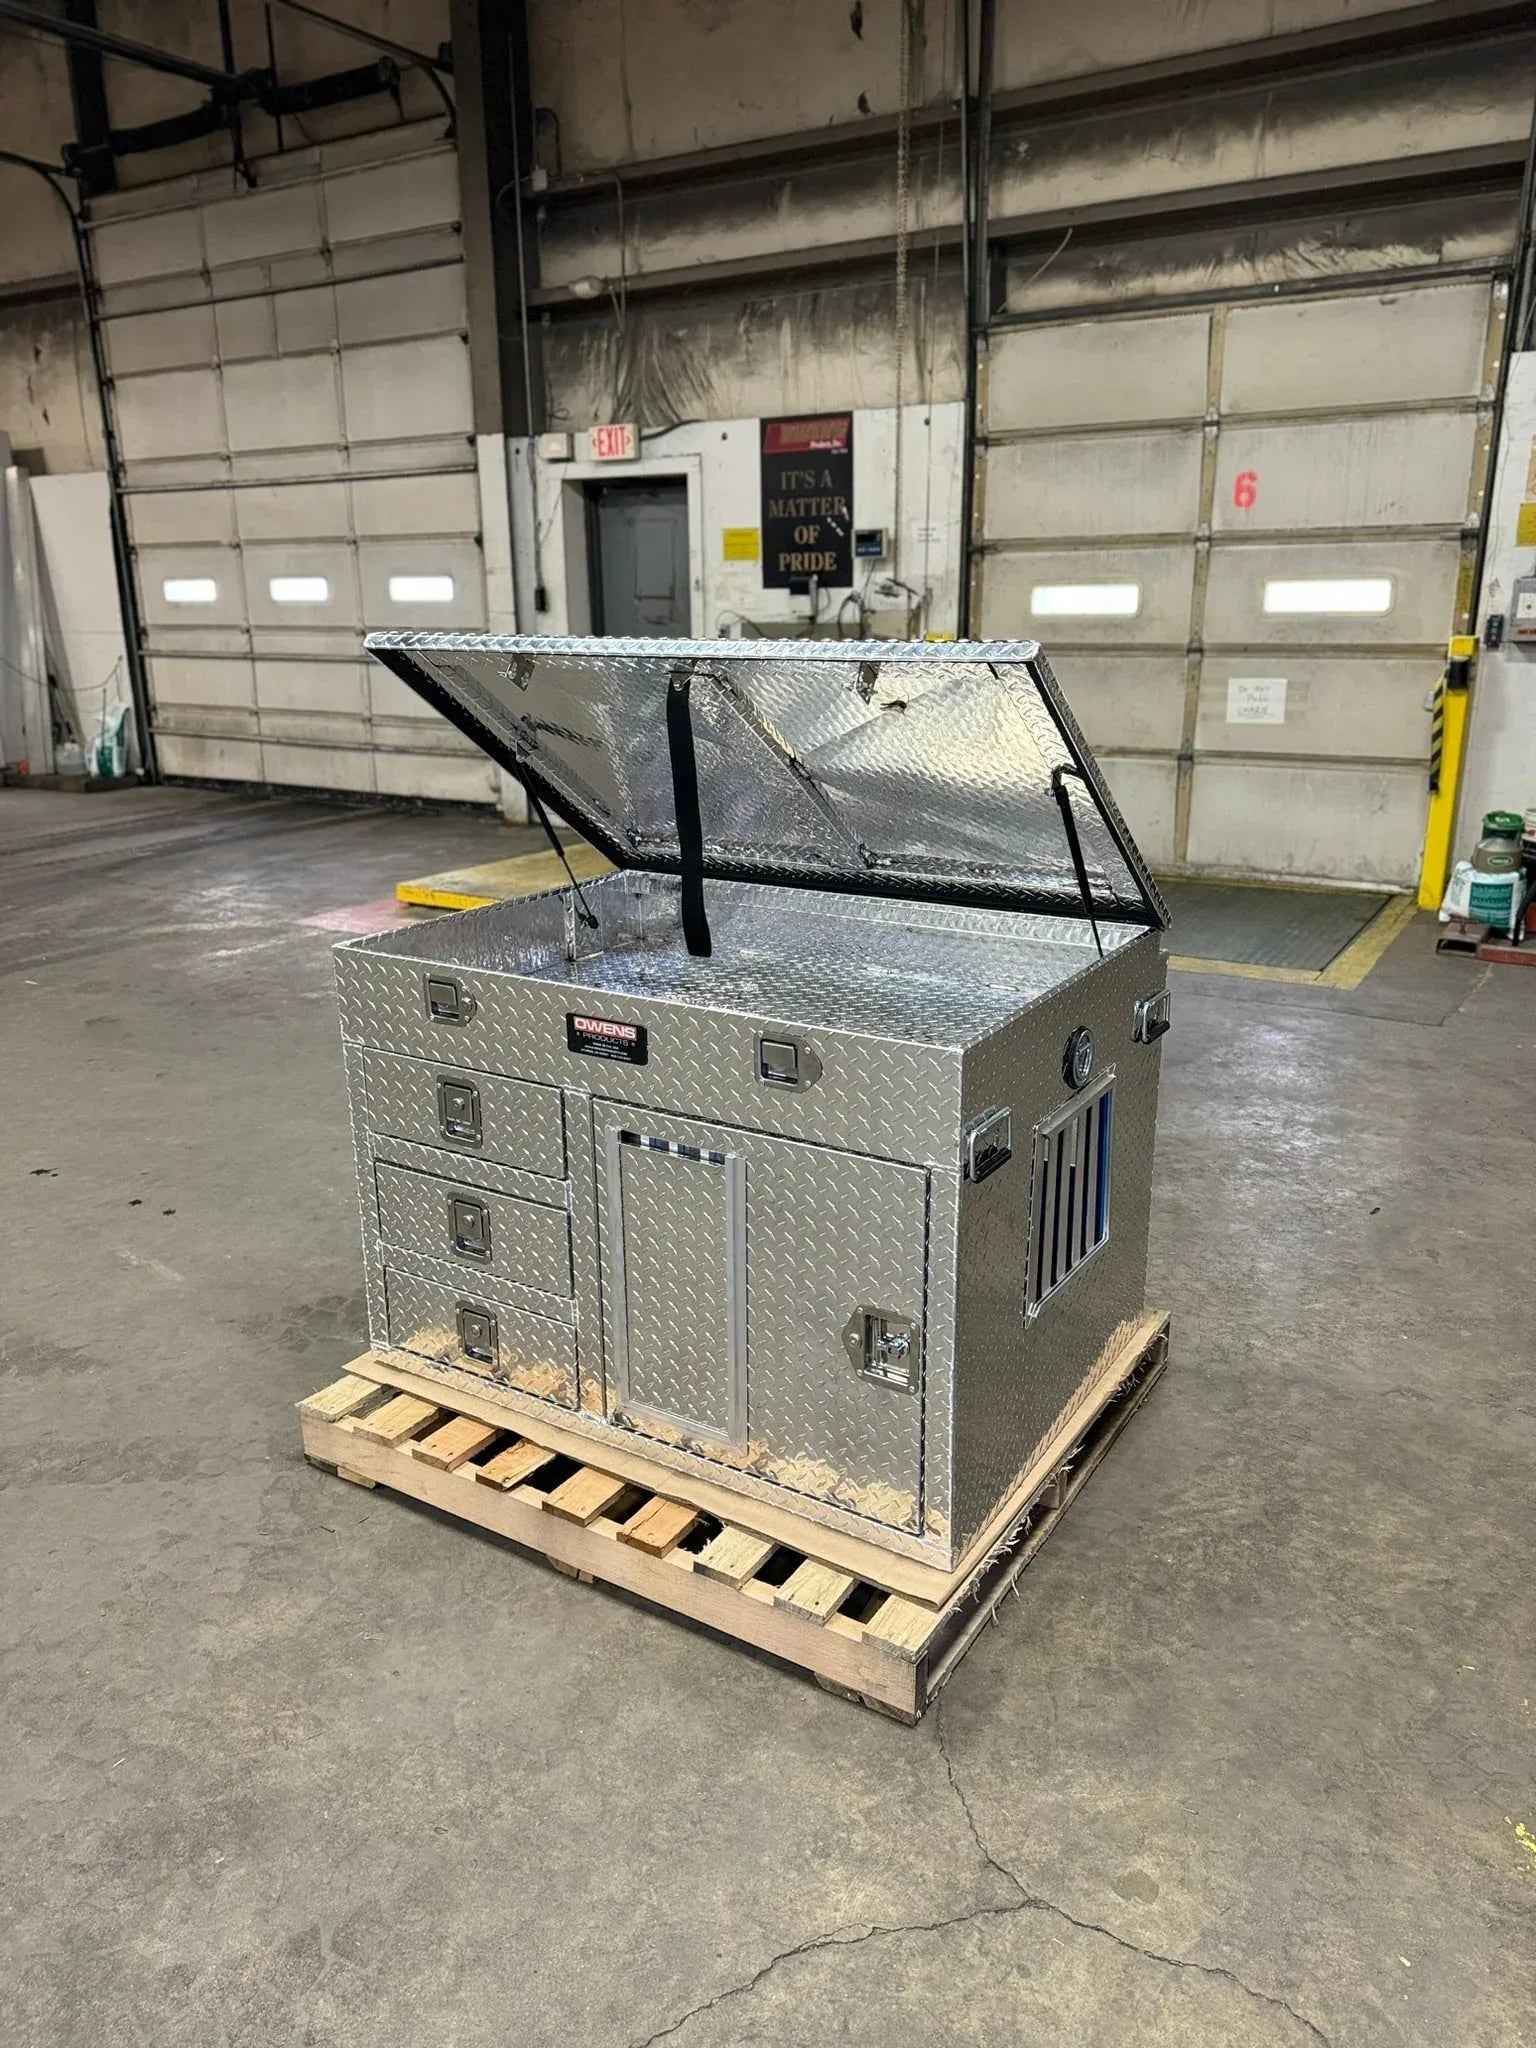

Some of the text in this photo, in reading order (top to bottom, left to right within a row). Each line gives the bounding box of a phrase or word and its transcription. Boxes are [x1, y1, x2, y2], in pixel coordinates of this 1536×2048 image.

[598, 427, 625, 457] EXIT
[781, 468, 833, 490] IT'S A
[1234, 470, 1257, 511] 6
[768, 496, 848, 518] MATTER
[794, 525, 820, 545] OF
[778, 551, 837, 572] PRIDE
[575, 1018, 637, 1040] OWENS
[583, 1032, 630, 1048] PRODUCTS
